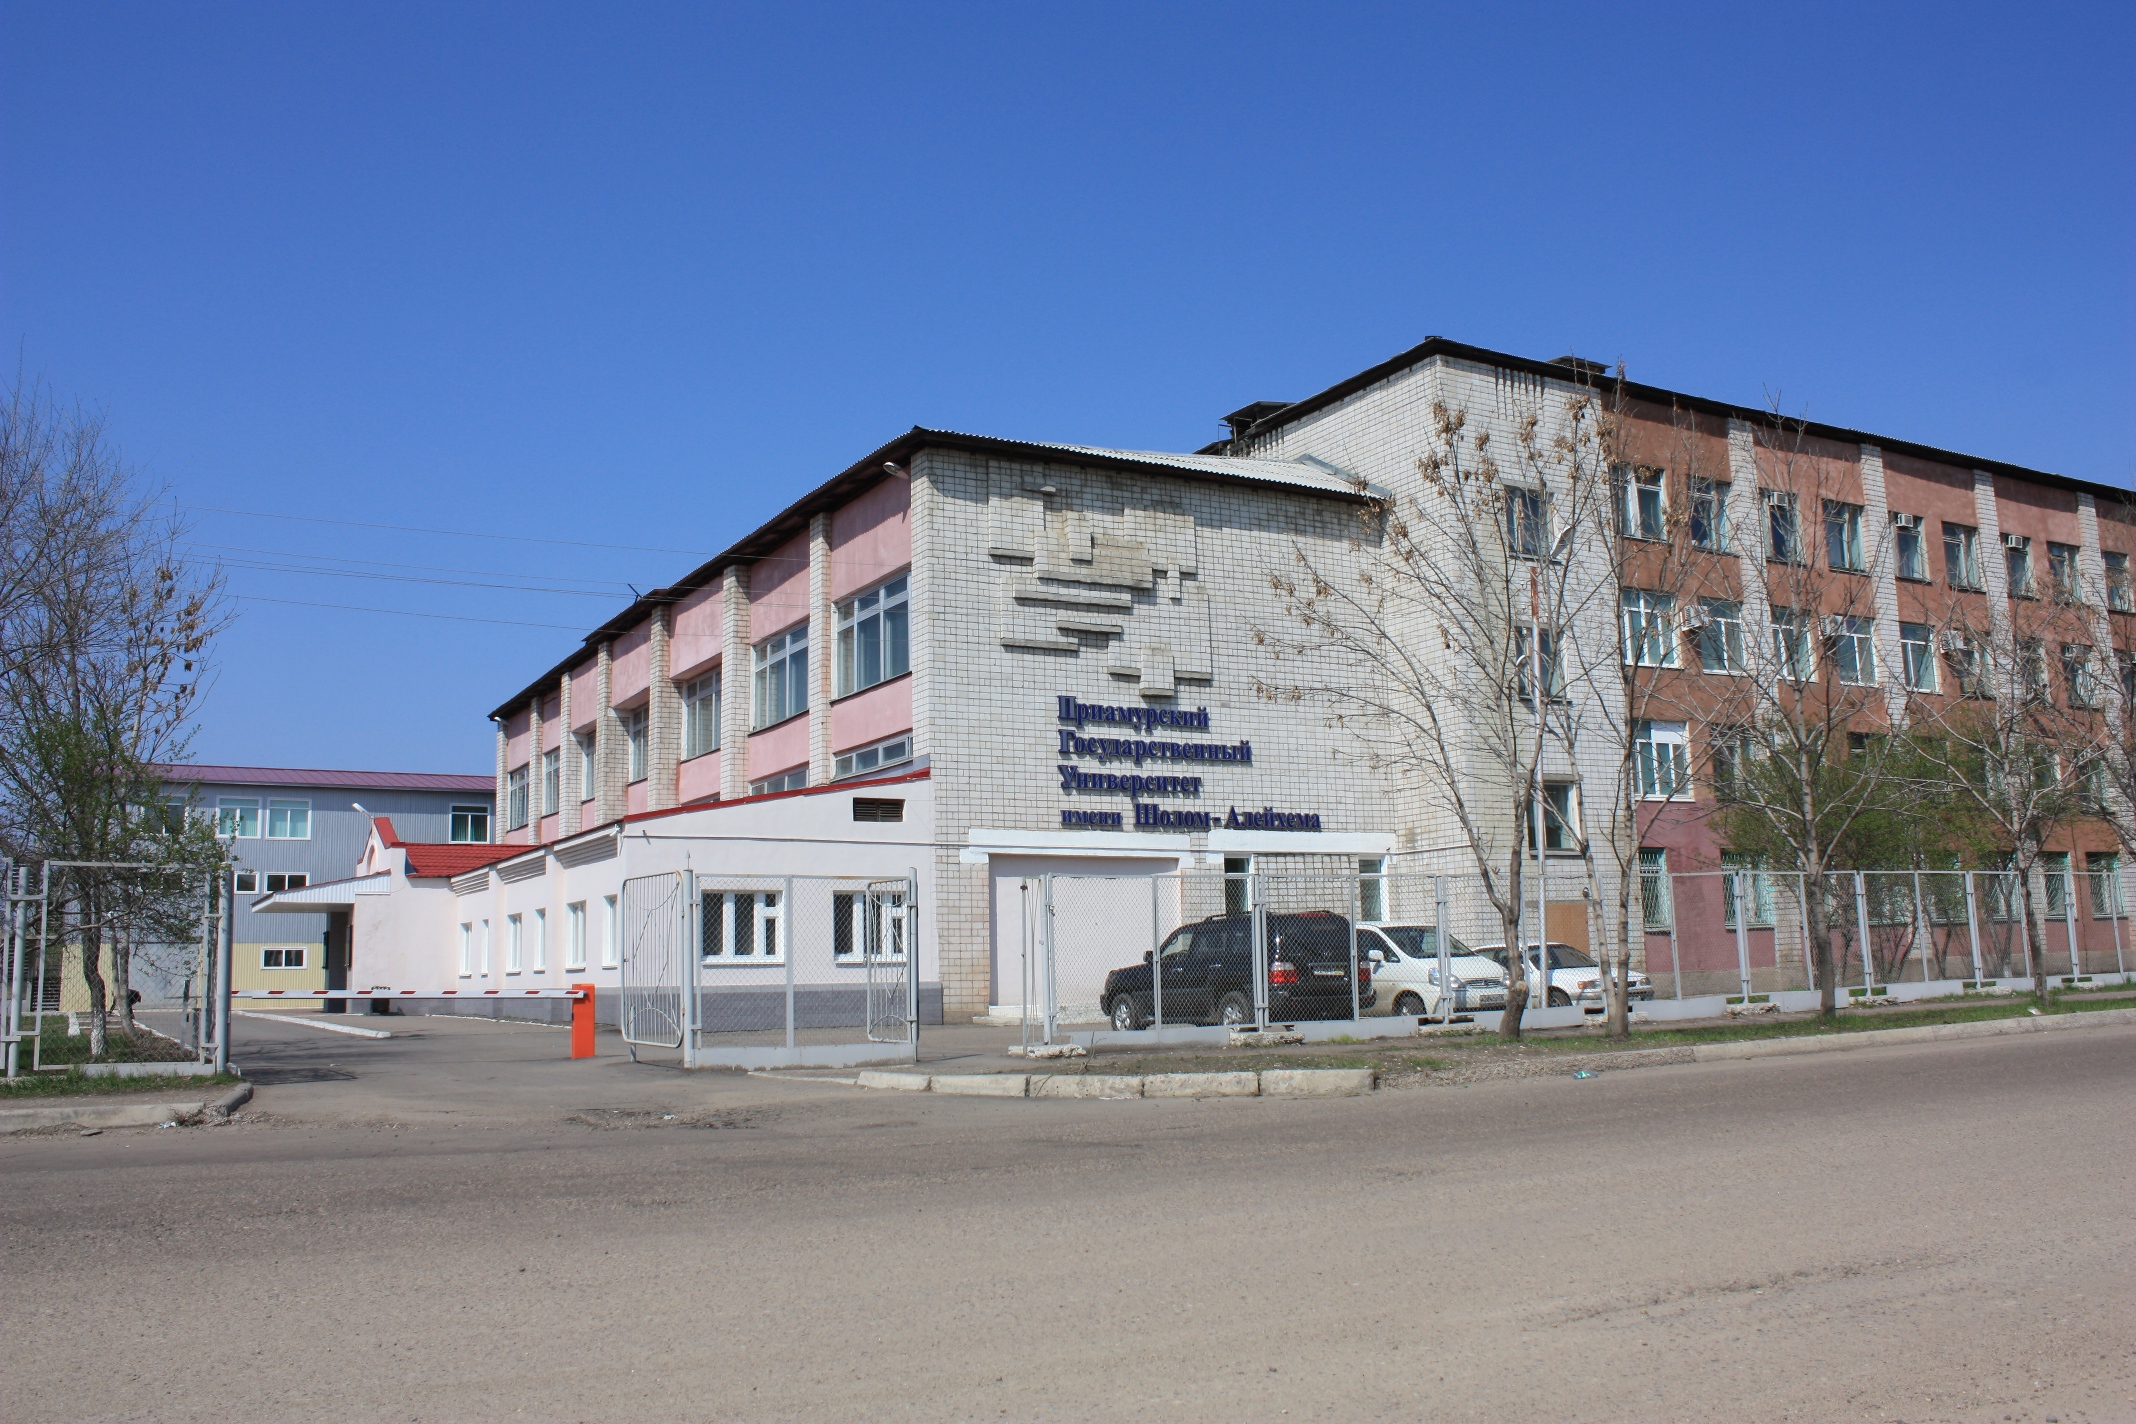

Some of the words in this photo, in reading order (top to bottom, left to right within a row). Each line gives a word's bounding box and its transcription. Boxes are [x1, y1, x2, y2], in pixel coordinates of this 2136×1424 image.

[1057, 695, 1209, 730] Приамурский
[1058, 729, 1251, 763] Государственный
[1057, 765, 1202, 796] Университет
[1060, 809, 1122, 827] имени
